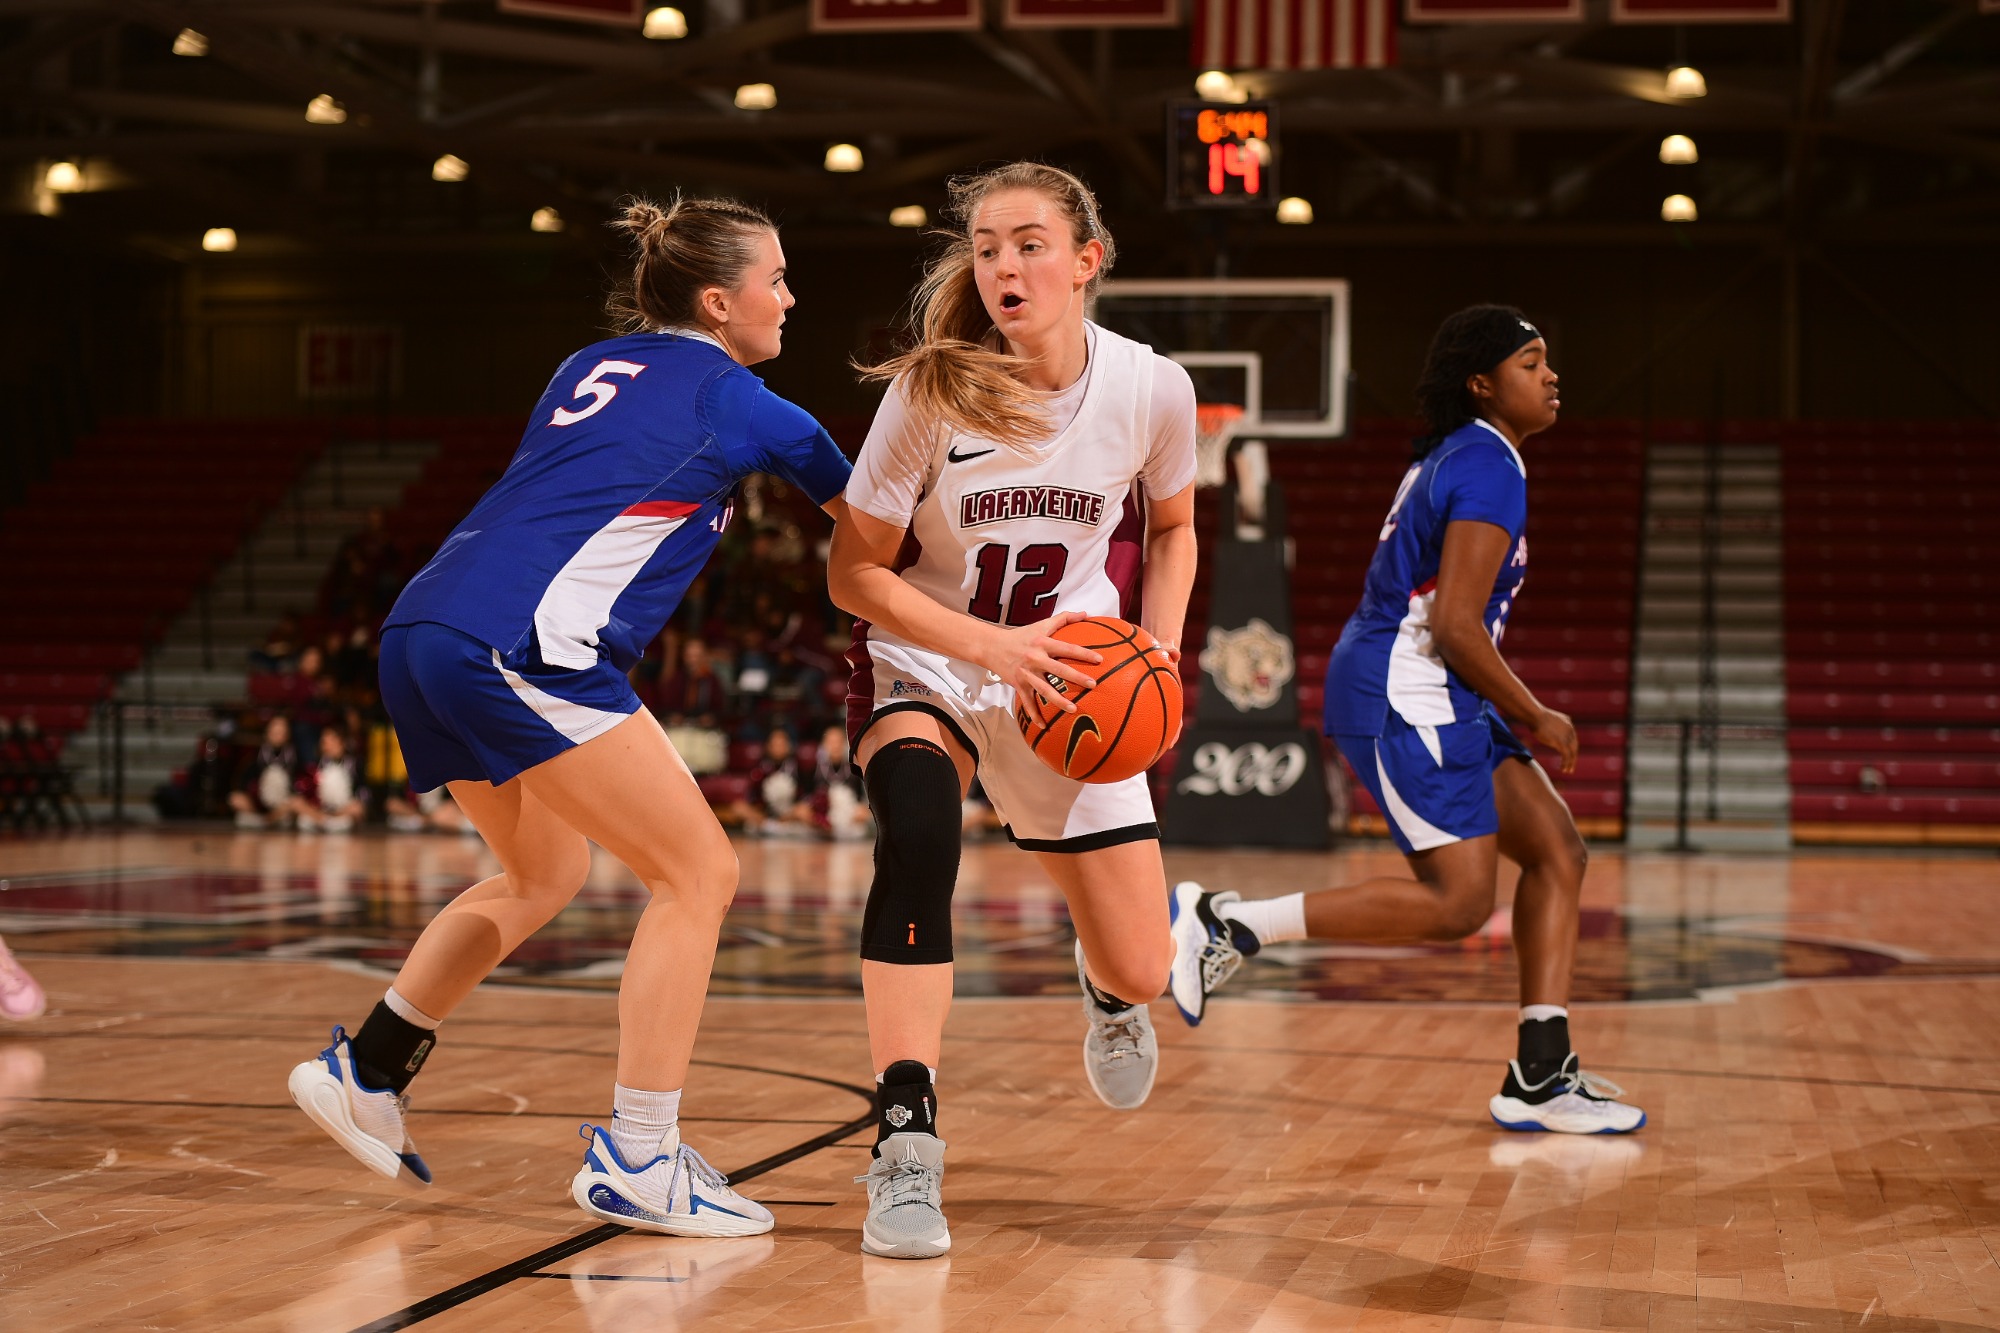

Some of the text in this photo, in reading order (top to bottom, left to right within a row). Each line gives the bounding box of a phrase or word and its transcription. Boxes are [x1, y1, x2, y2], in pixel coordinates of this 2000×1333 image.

[1209, 143, 1259, 195] 14
[546, 358, 649, 428] 5
[962, 486, 1104, 526] LAFAYETTE
[968, 543, 1069, 627] 12
[1177, 742, 1307, 796] 200
